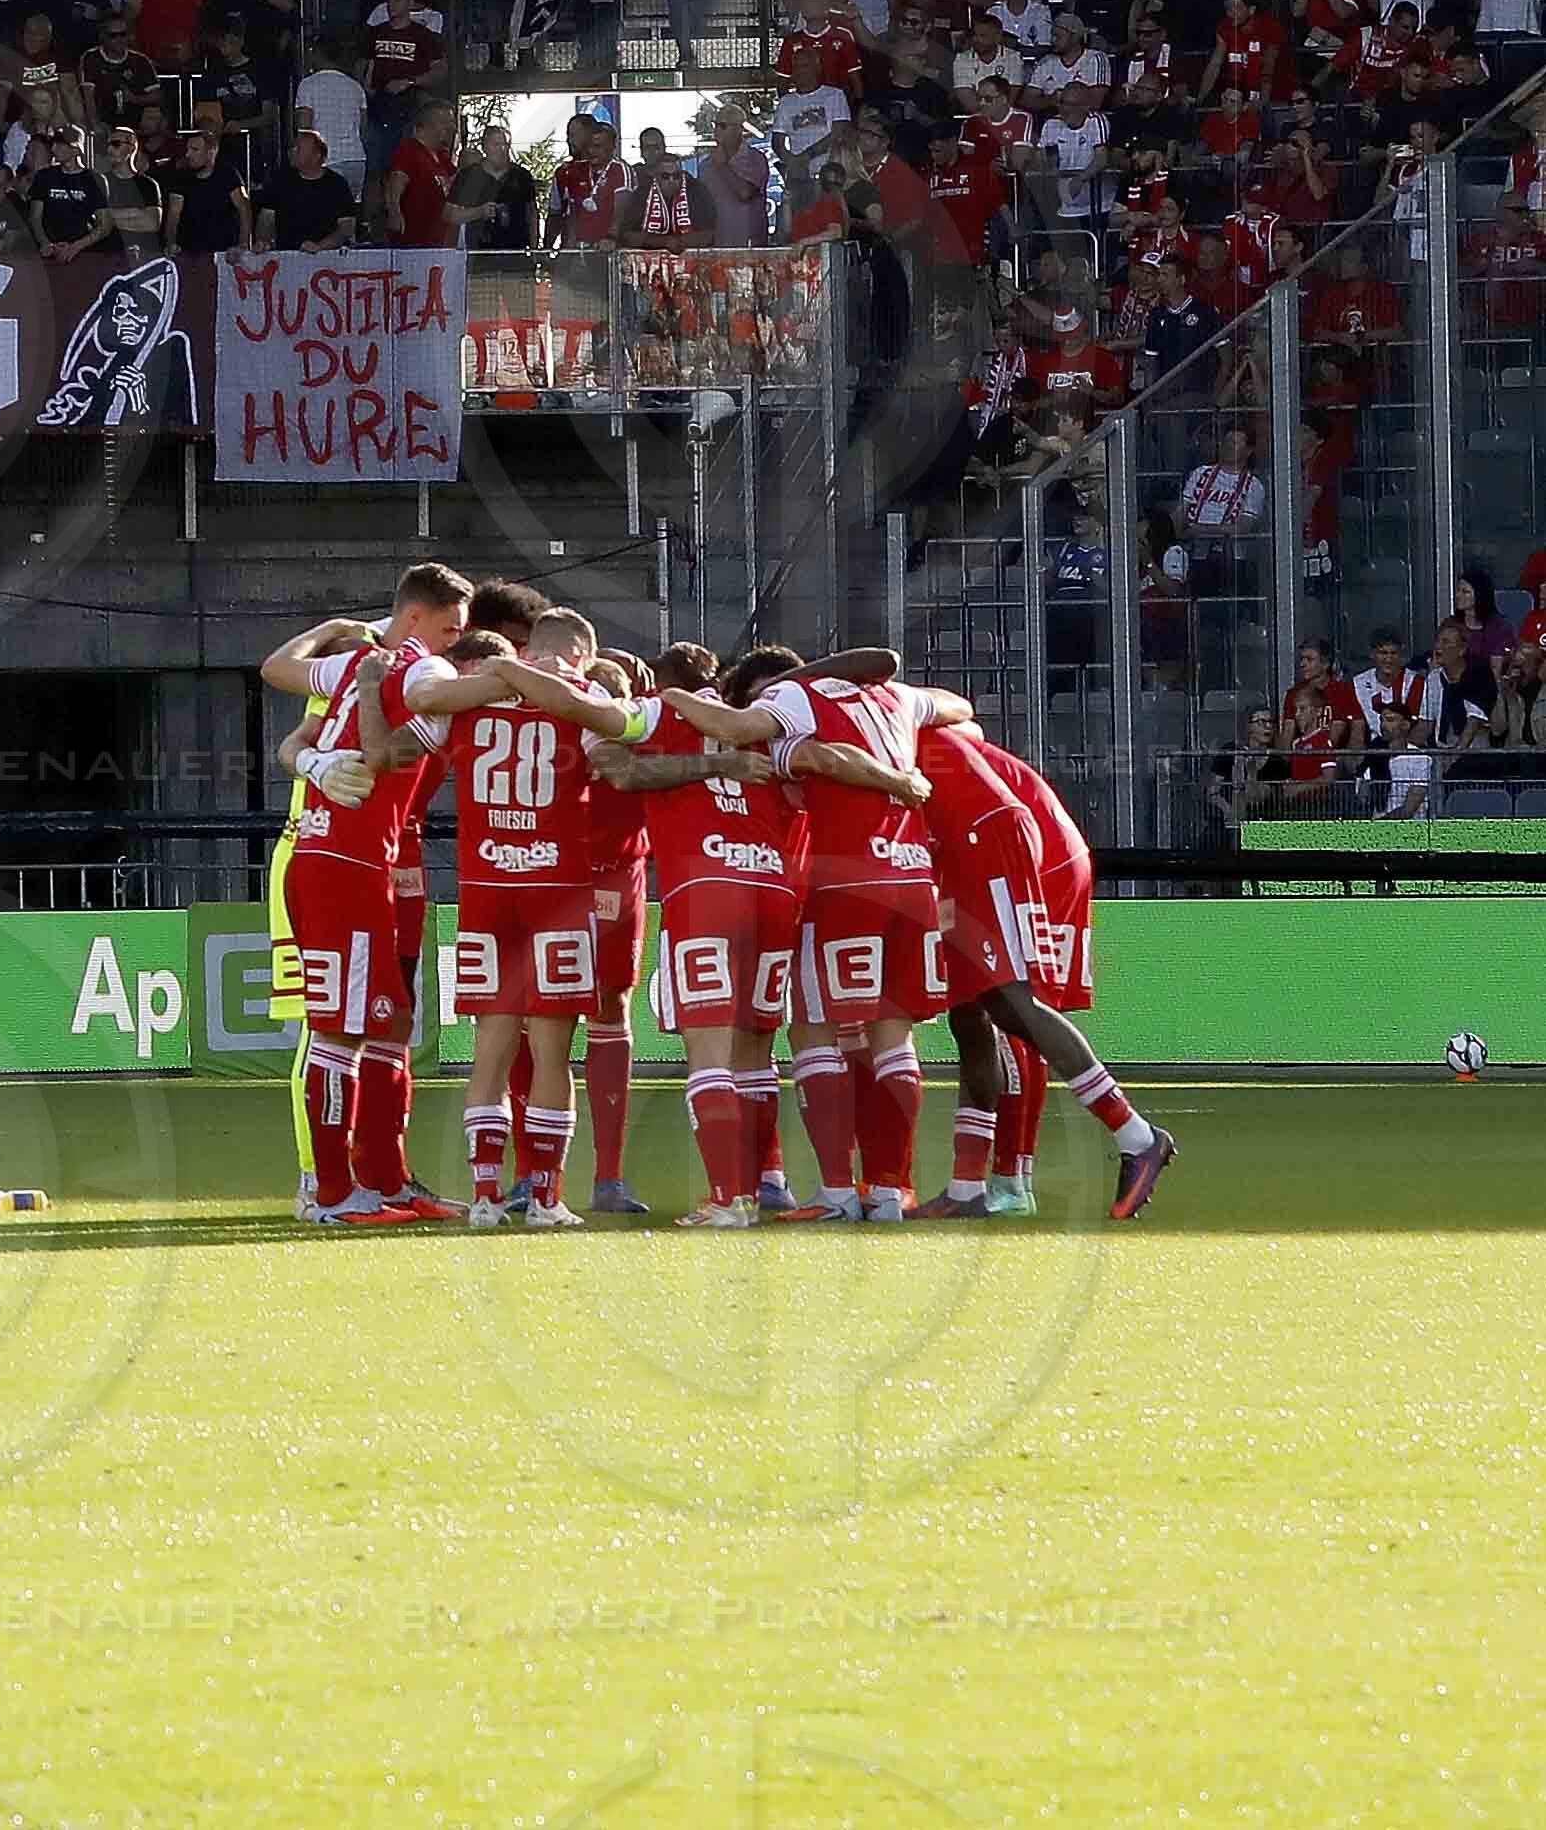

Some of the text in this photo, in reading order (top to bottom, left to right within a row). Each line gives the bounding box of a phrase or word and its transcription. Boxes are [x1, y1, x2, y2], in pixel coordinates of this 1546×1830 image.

[234, 259, 451, 344] JUSTITIA
[293, 337, 380, 390] DU
[241, 388, 448, 474] HURE
[473, 717, 557, 808] 28
[487, 808, 537, 831] FRIESER
